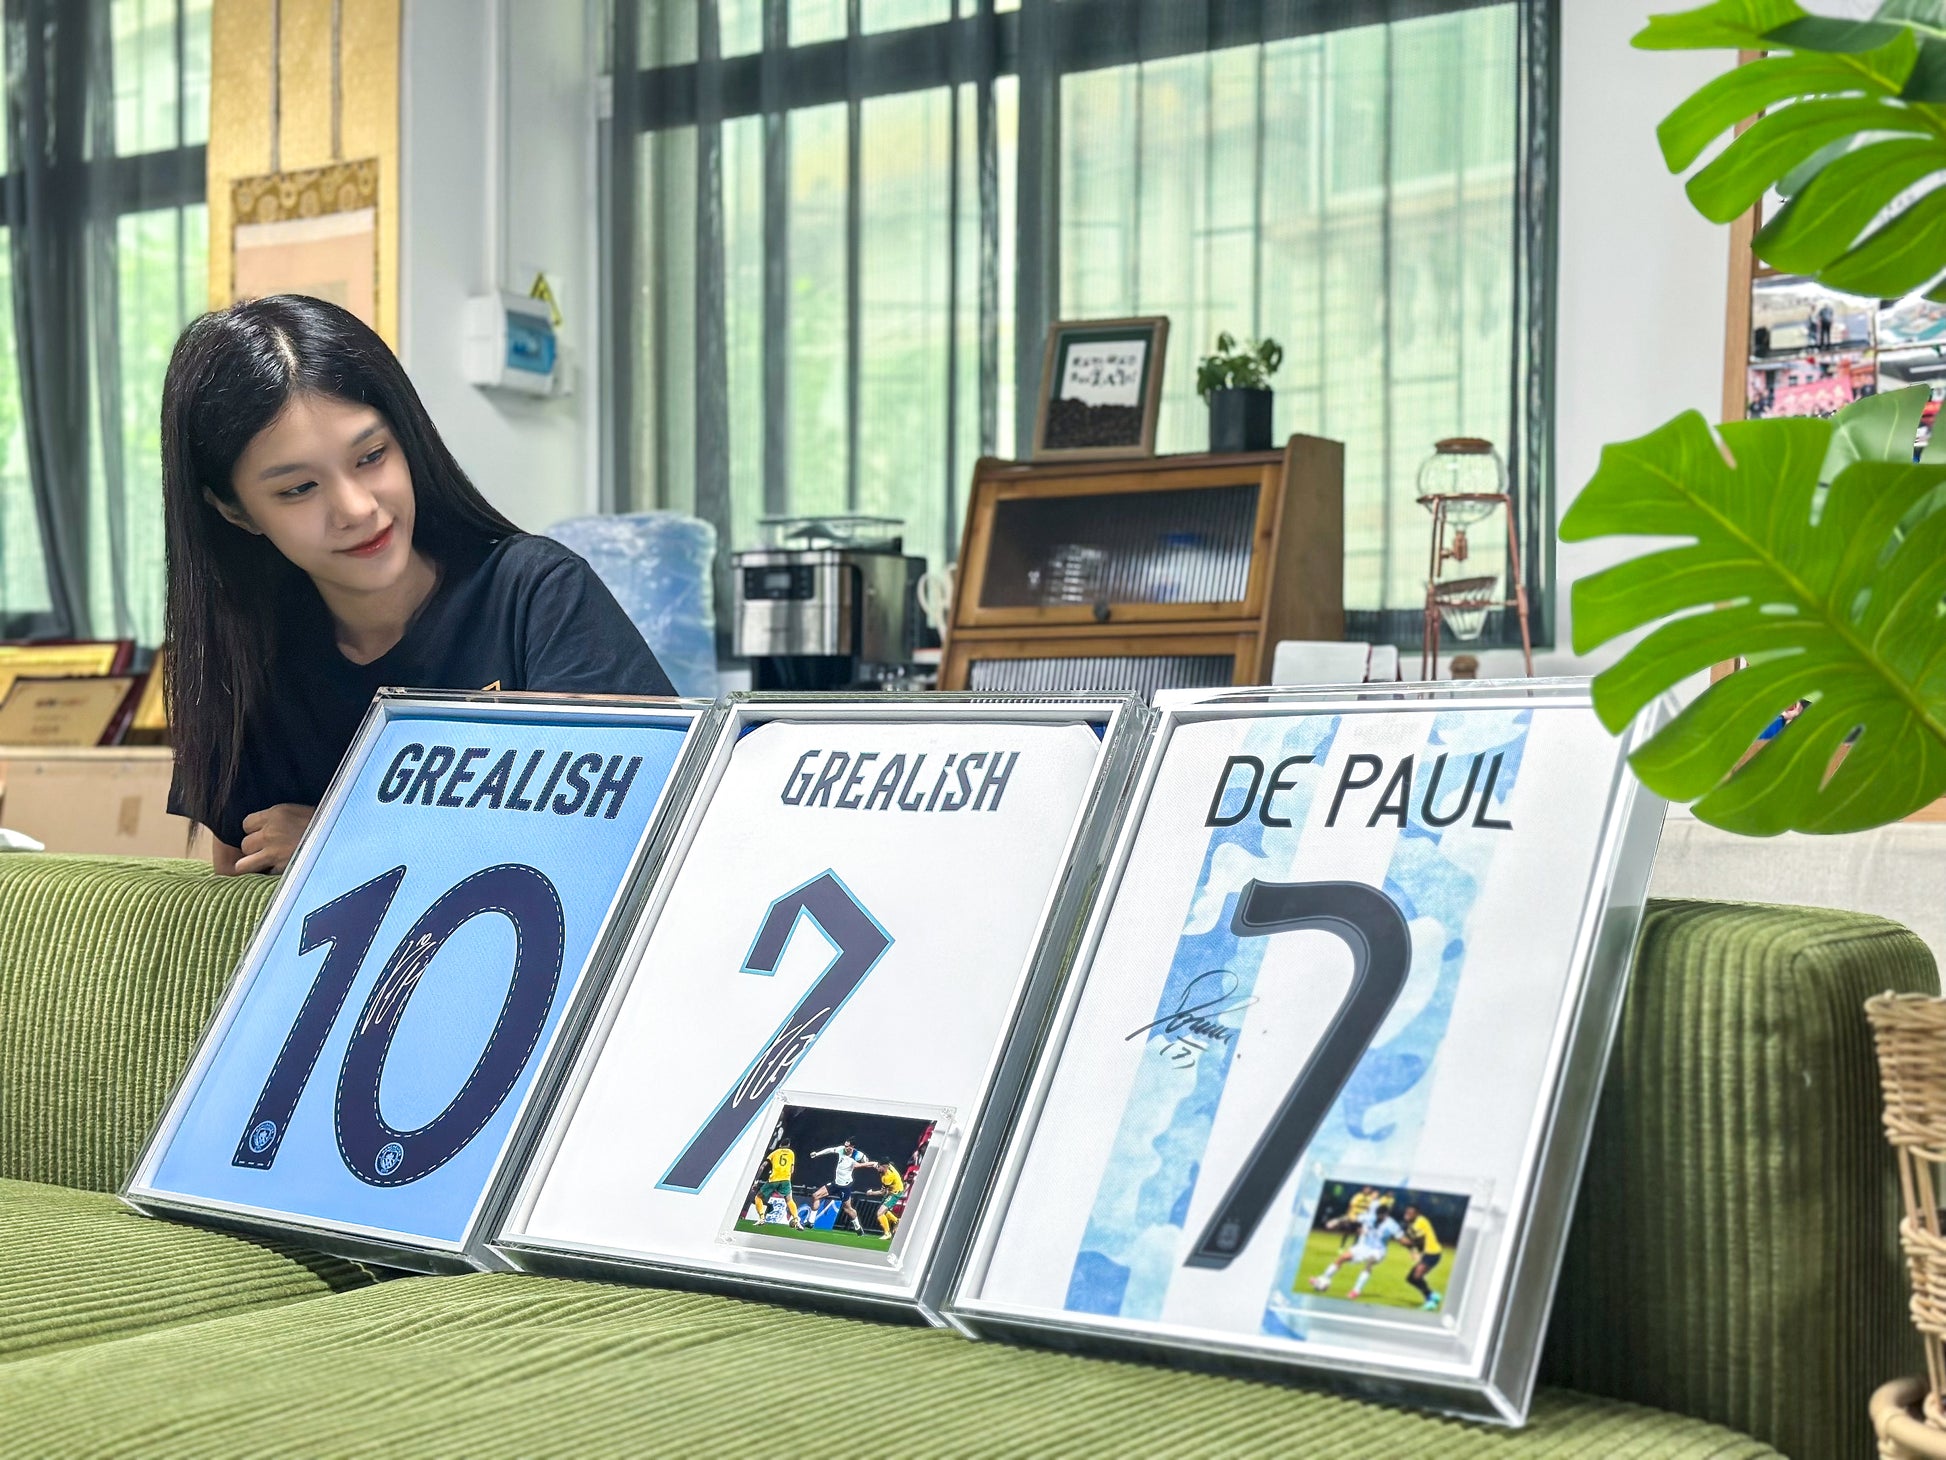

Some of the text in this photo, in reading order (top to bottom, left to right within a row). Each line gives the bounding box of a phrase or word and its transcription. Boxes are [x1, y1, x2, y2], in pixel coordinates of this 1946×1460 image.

[377, 743, 643, 819] GREALISH
[1204, 752, 1513, 830] DE PAUL
[231, 864, 565, 1188] 10
[654, 868, 895, 1194] 7
[1183, 878, 1412, 1270] 7
[779, 1153, 788, 1167] 6
